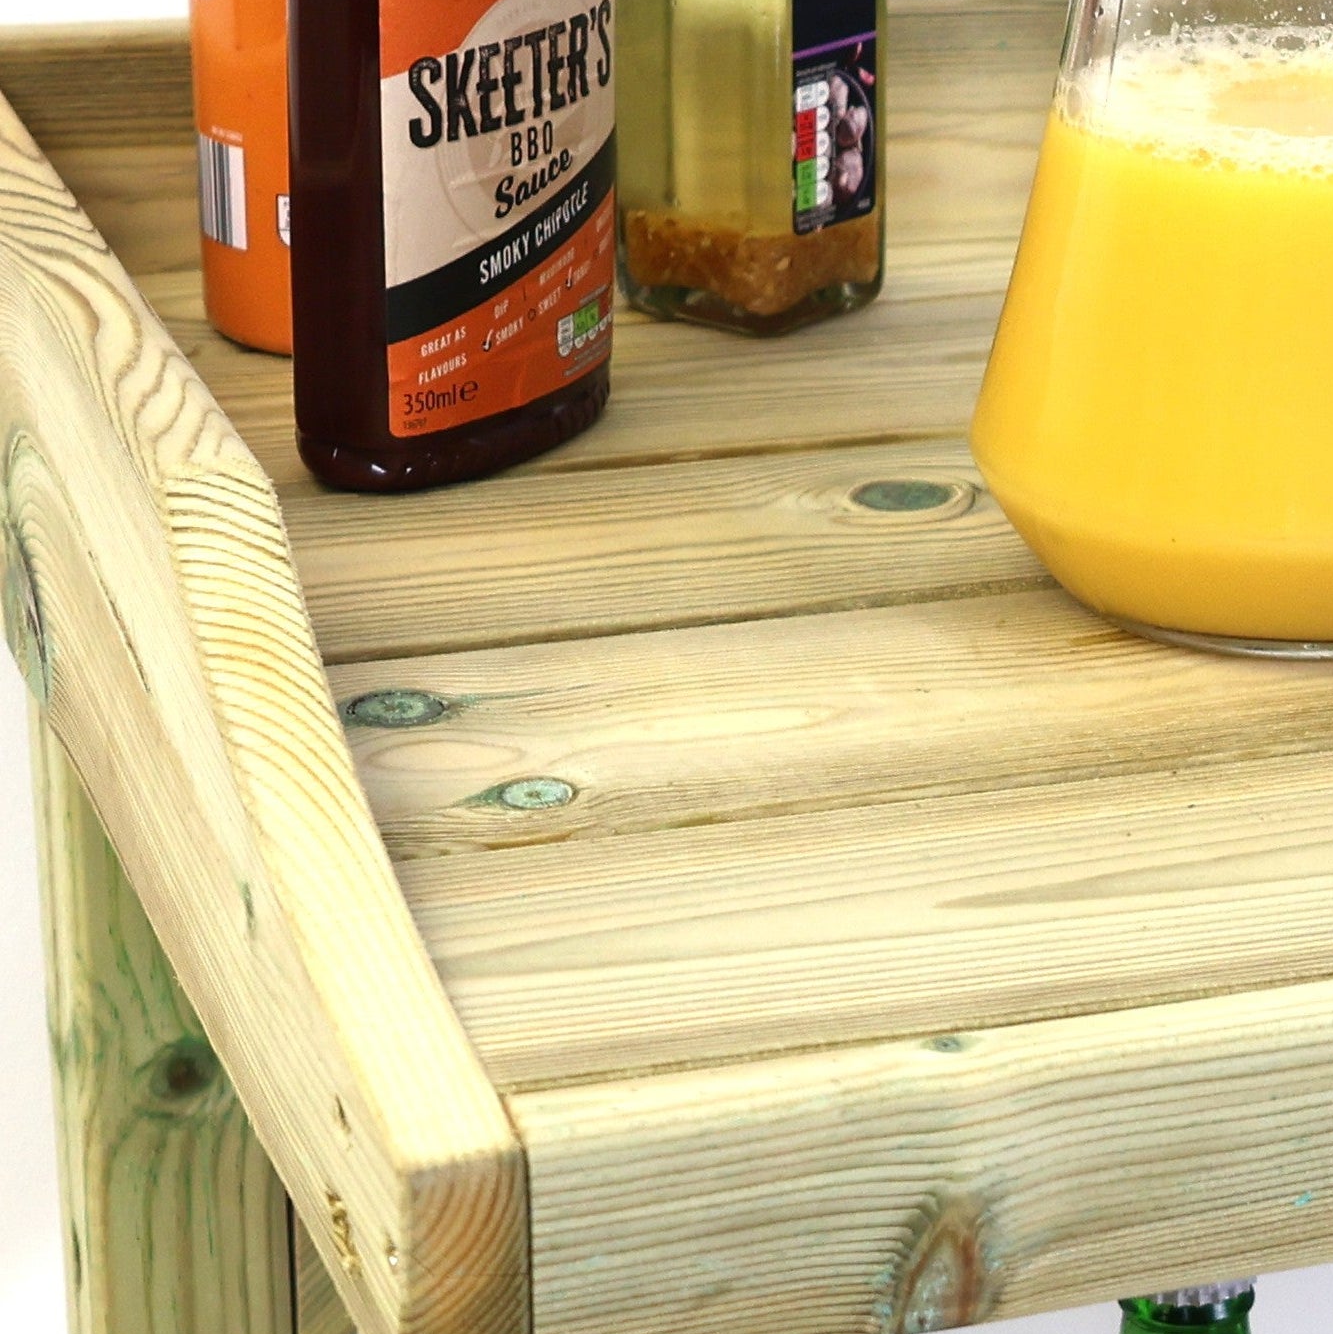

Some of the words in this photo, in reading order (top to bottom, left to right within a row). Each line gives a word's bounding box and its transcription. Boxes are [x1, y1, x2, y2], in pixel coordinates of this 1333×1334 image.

[494, 148, 573, 219] Sauce
[480, 232, 531, 285] SMOKY
[535, 180, 589, 247] CHIPOTLE
[418, 353, 467, 385] FLAVOURS
[495, 317, 524, 346] SMOKY
[537, 287, 562, 315] SWEET
[421, 335, 452, 357] GREAT
[454, 326, 467, 342] AS
[404, 388, 457, 416] 350ml
